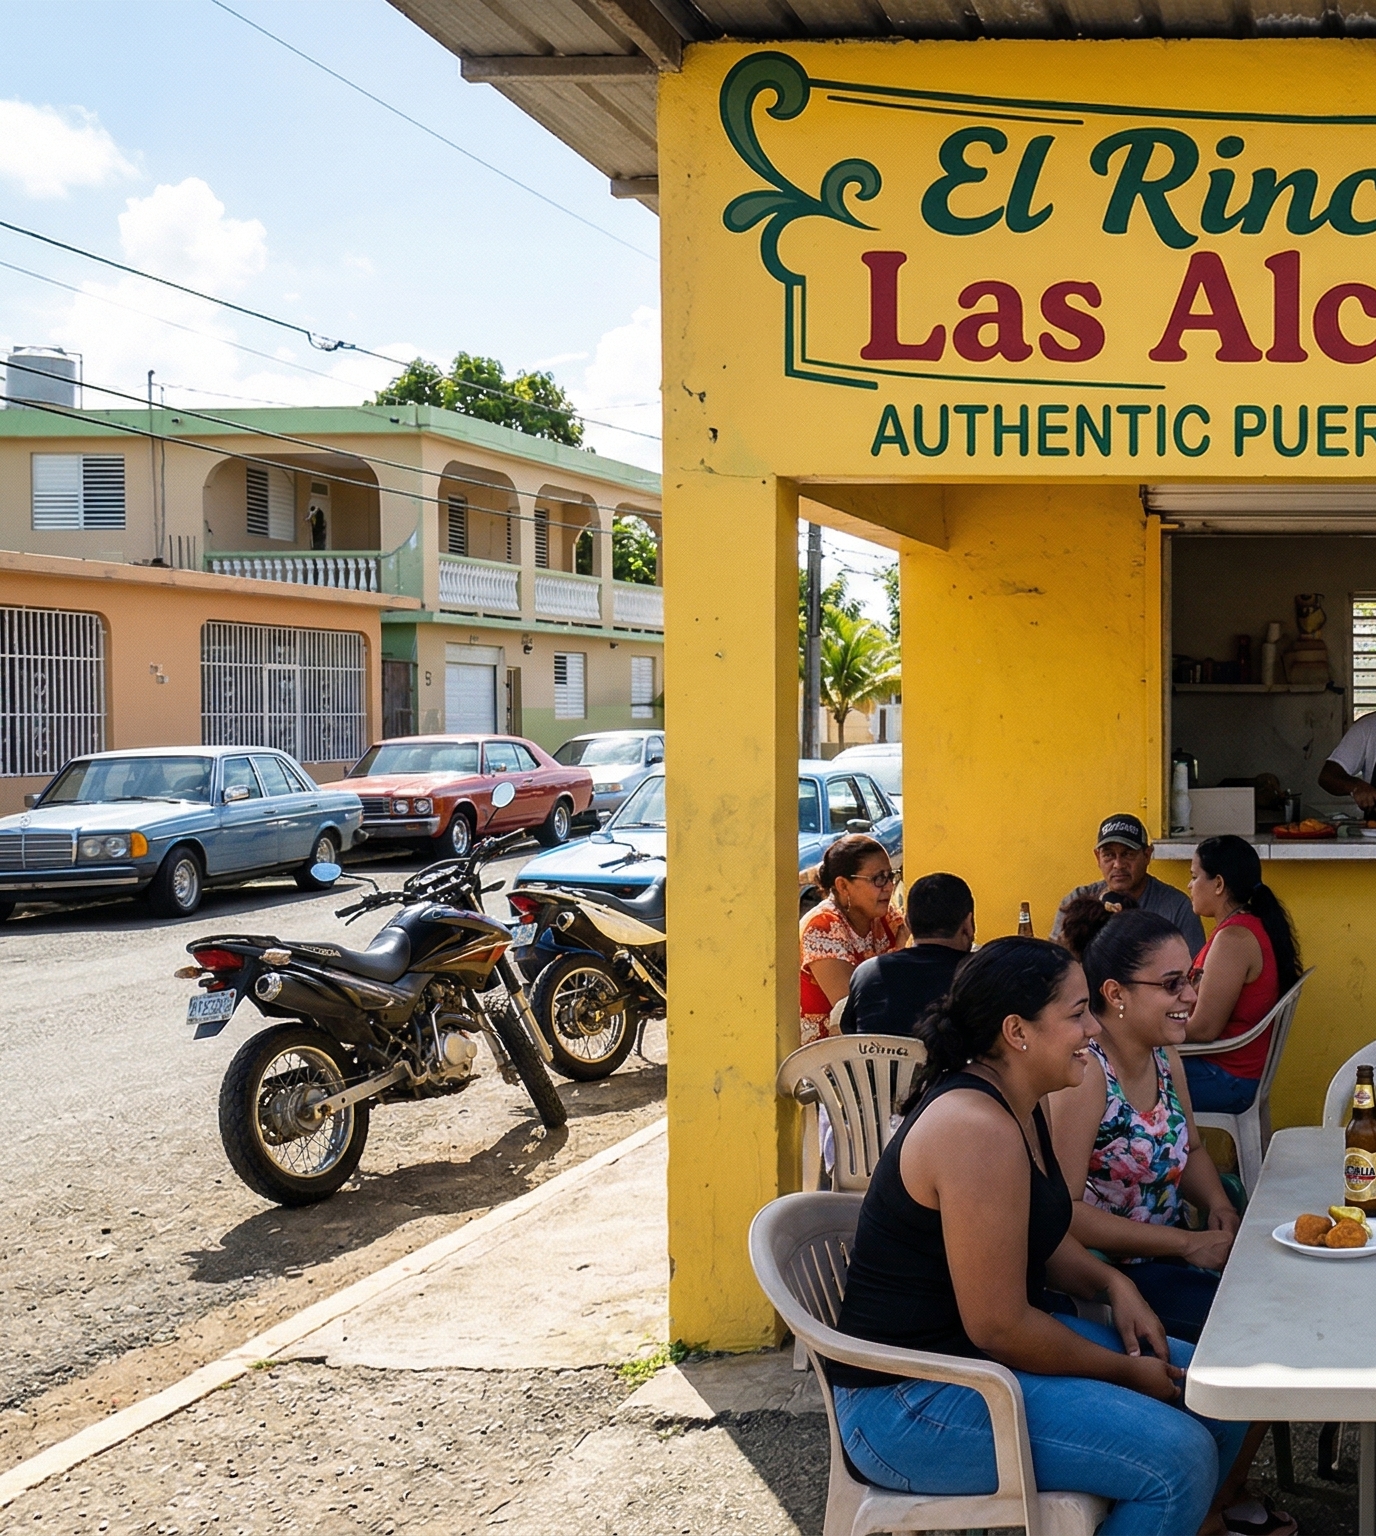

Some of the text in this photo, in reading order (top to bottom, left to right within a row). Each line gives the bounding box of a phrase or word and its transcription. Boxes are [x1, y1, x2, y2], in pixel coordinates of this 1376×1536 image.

[921, 126, 1055, 235] El
[859, 250, 1106, 363] Las
[871, 404, 1210, 457] AUTHENTIC
